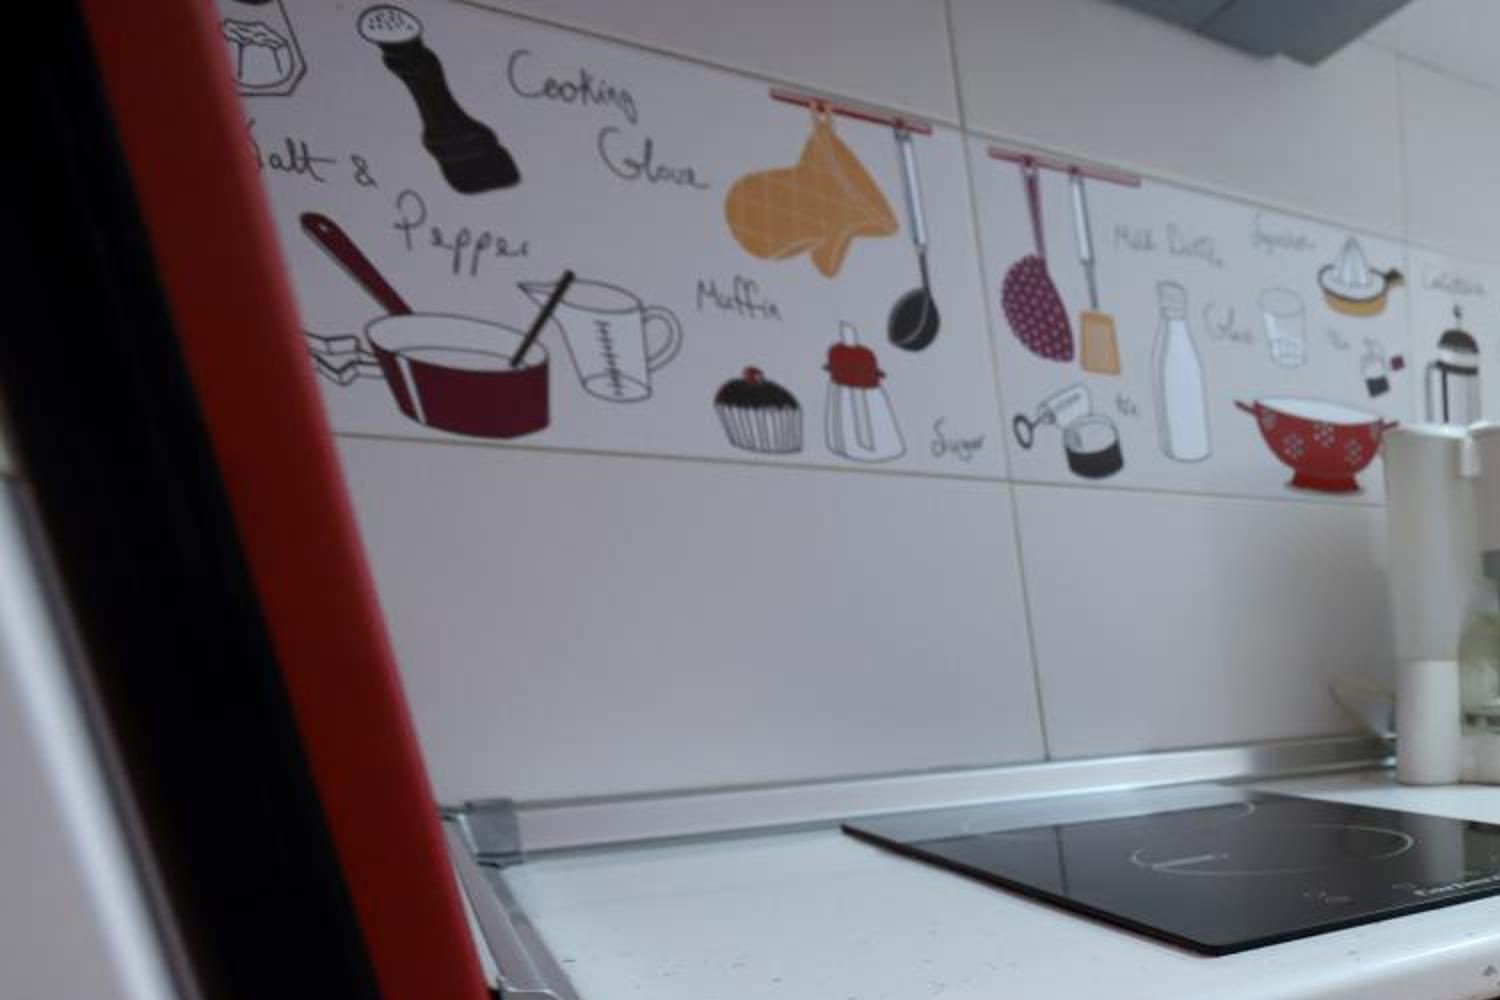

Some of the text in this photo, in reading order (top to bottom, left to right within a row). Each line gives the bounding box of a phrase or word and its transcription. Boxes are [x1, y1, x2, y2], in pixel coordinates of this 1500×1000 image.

[507, 48, 638, 125] Cooking
[351, 153, 378, 188] &
[393, 189, 529, 277] Pepper
[696, 274, 783, 320] Muffin
